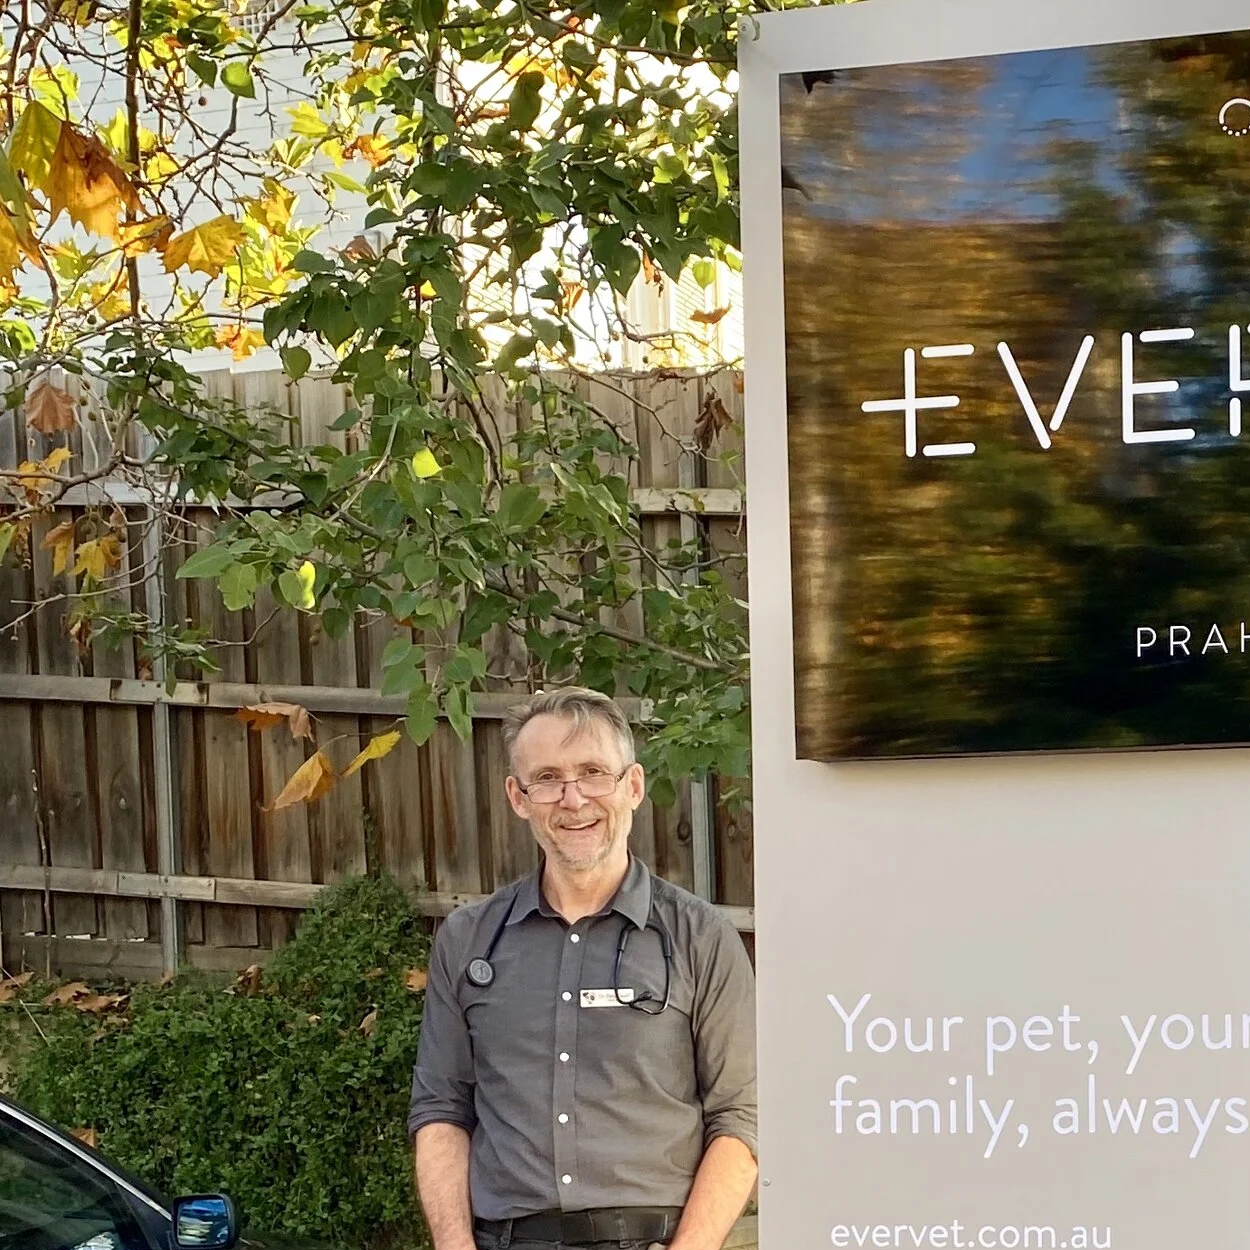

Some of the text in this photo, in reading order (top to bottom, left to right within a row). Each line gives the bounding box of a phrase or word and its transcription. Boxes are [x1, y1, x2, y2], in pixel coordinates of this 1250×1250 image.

[826, 993, 964, 1053] Your
[986, 1004, 1099, 1076] pet,
[829, 1075, 1029, 1159] family,
[830, 1219, 1113, 1249] evervet.com.au
